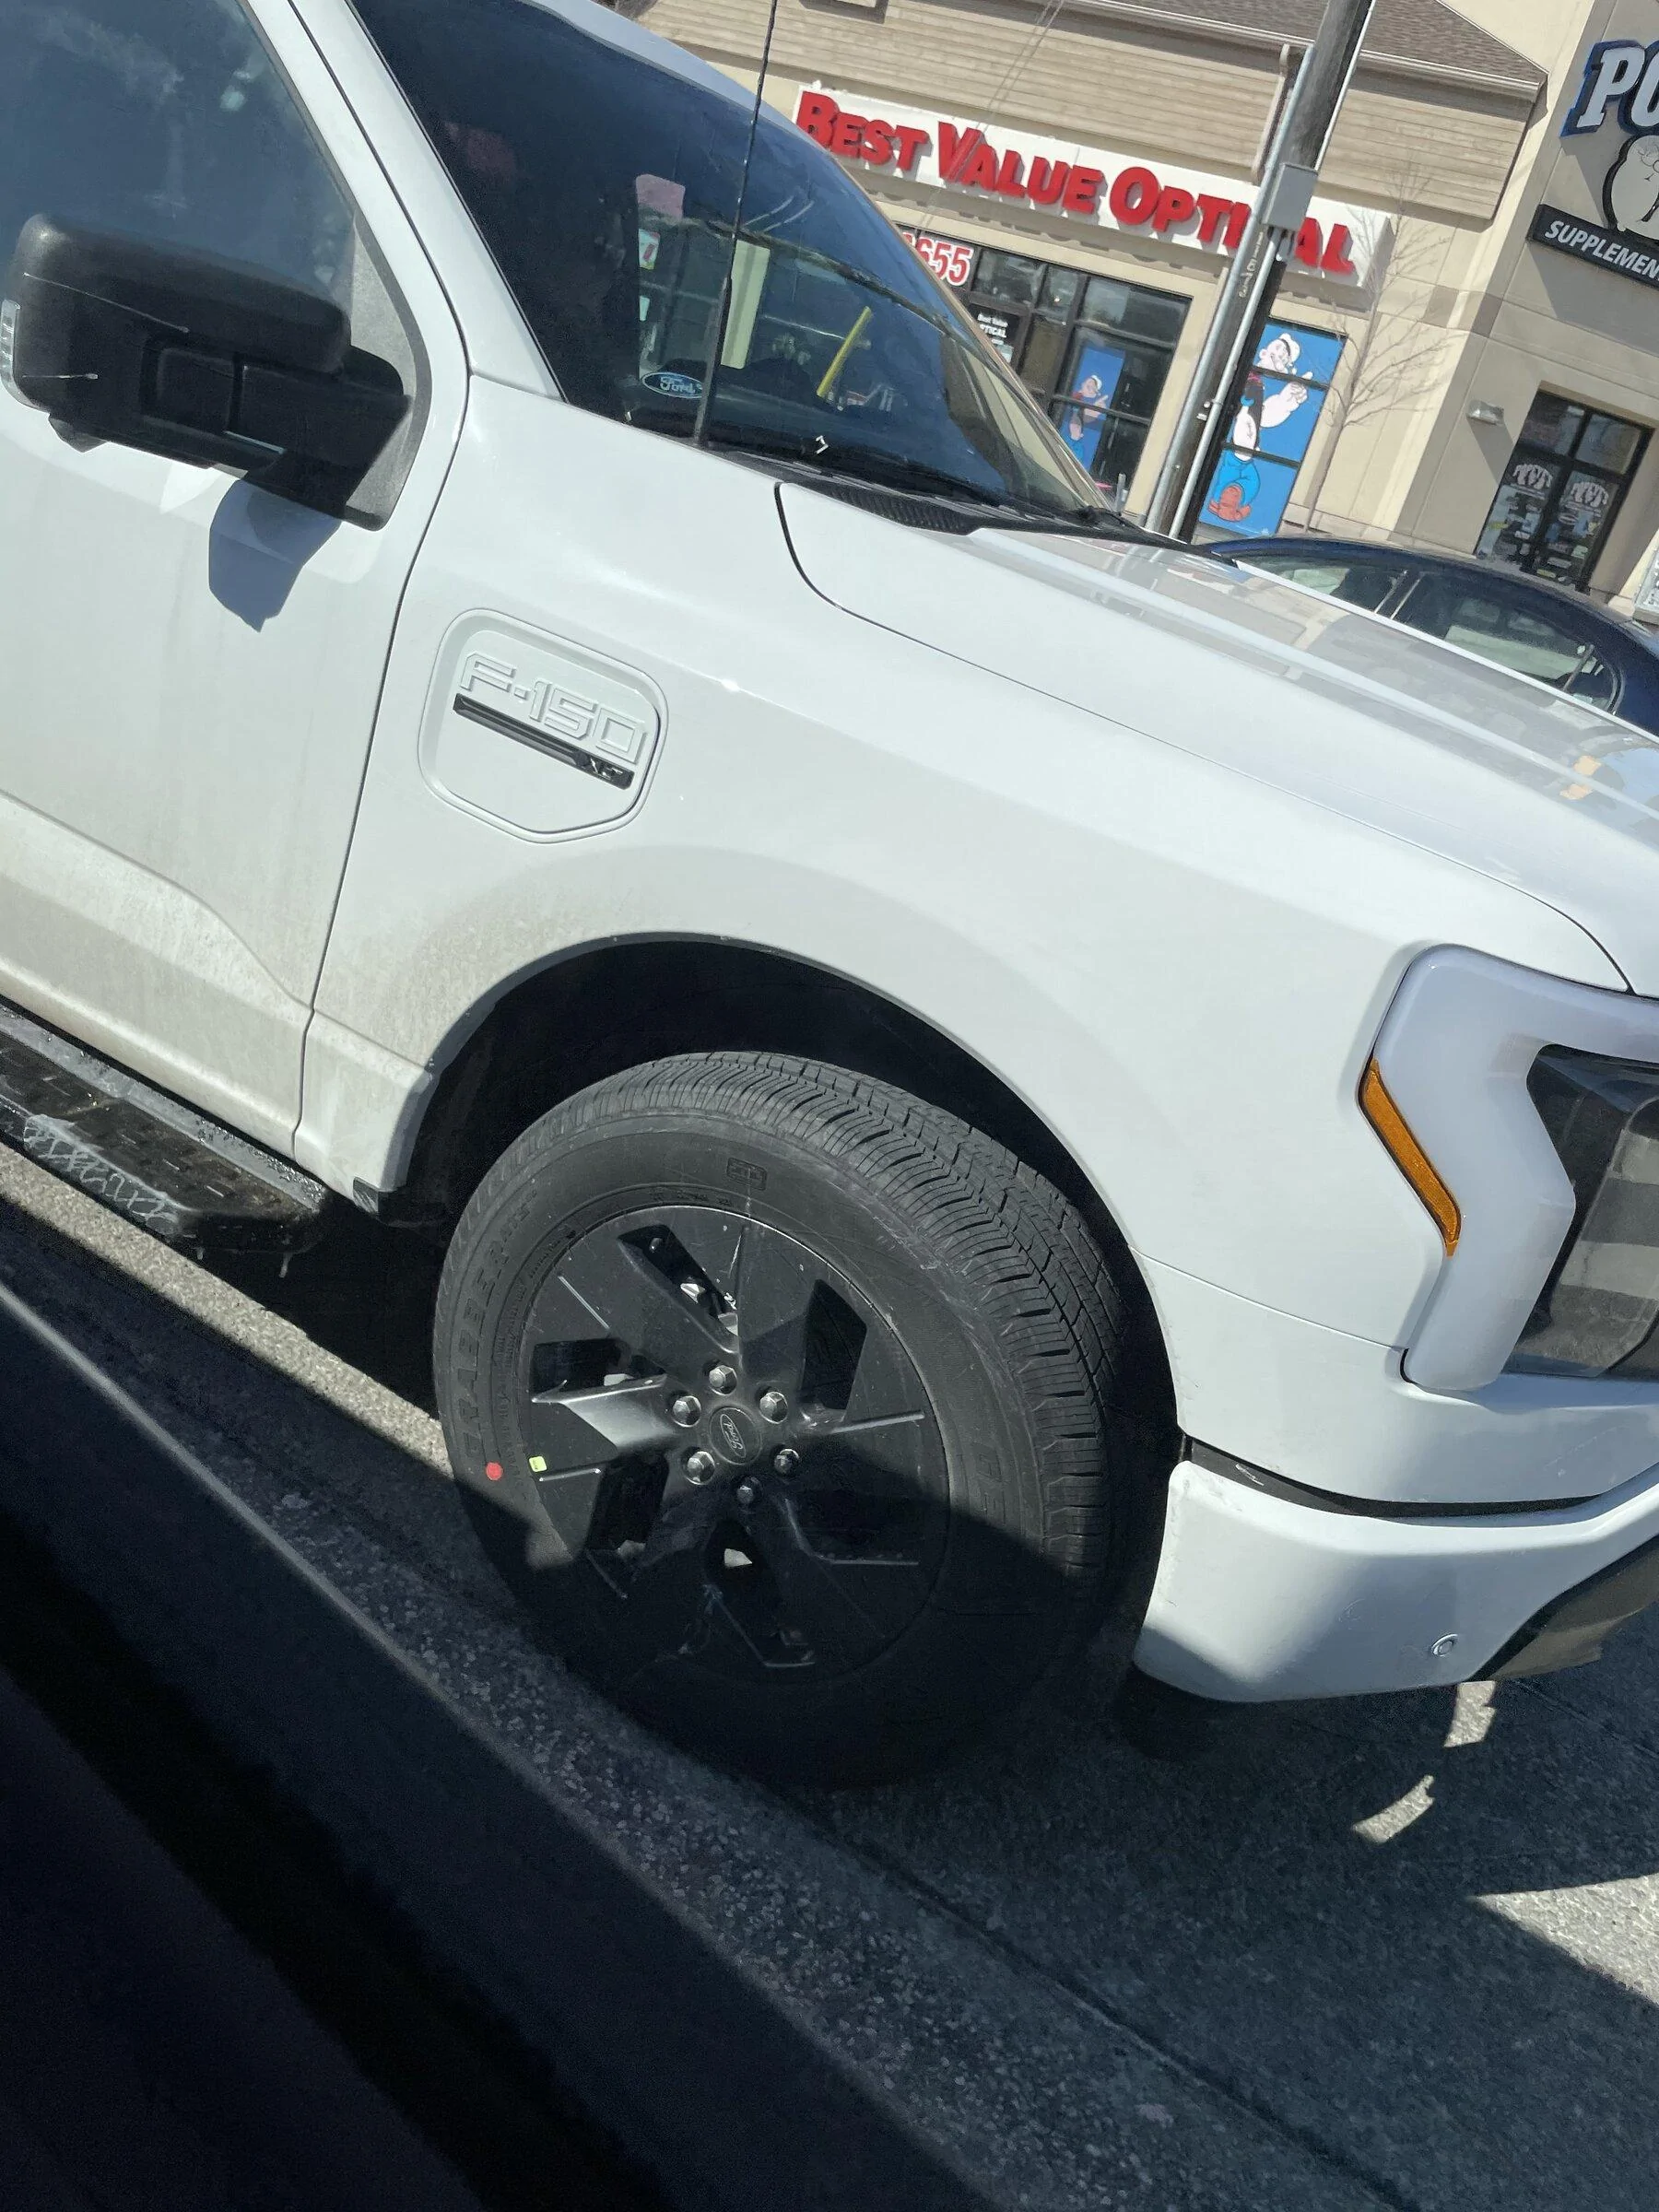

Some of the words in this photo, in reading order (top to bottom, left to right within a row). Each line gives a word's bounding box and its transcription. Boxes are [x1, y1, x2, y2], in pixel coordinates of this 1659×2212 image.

[1108, 166, 1356, 275] OPTIAL
[1545, 220, 1659, 281] SUPPLEMEN
[660, 376, 697, 394] Ford
[459, 652, 649, 765] F-150
